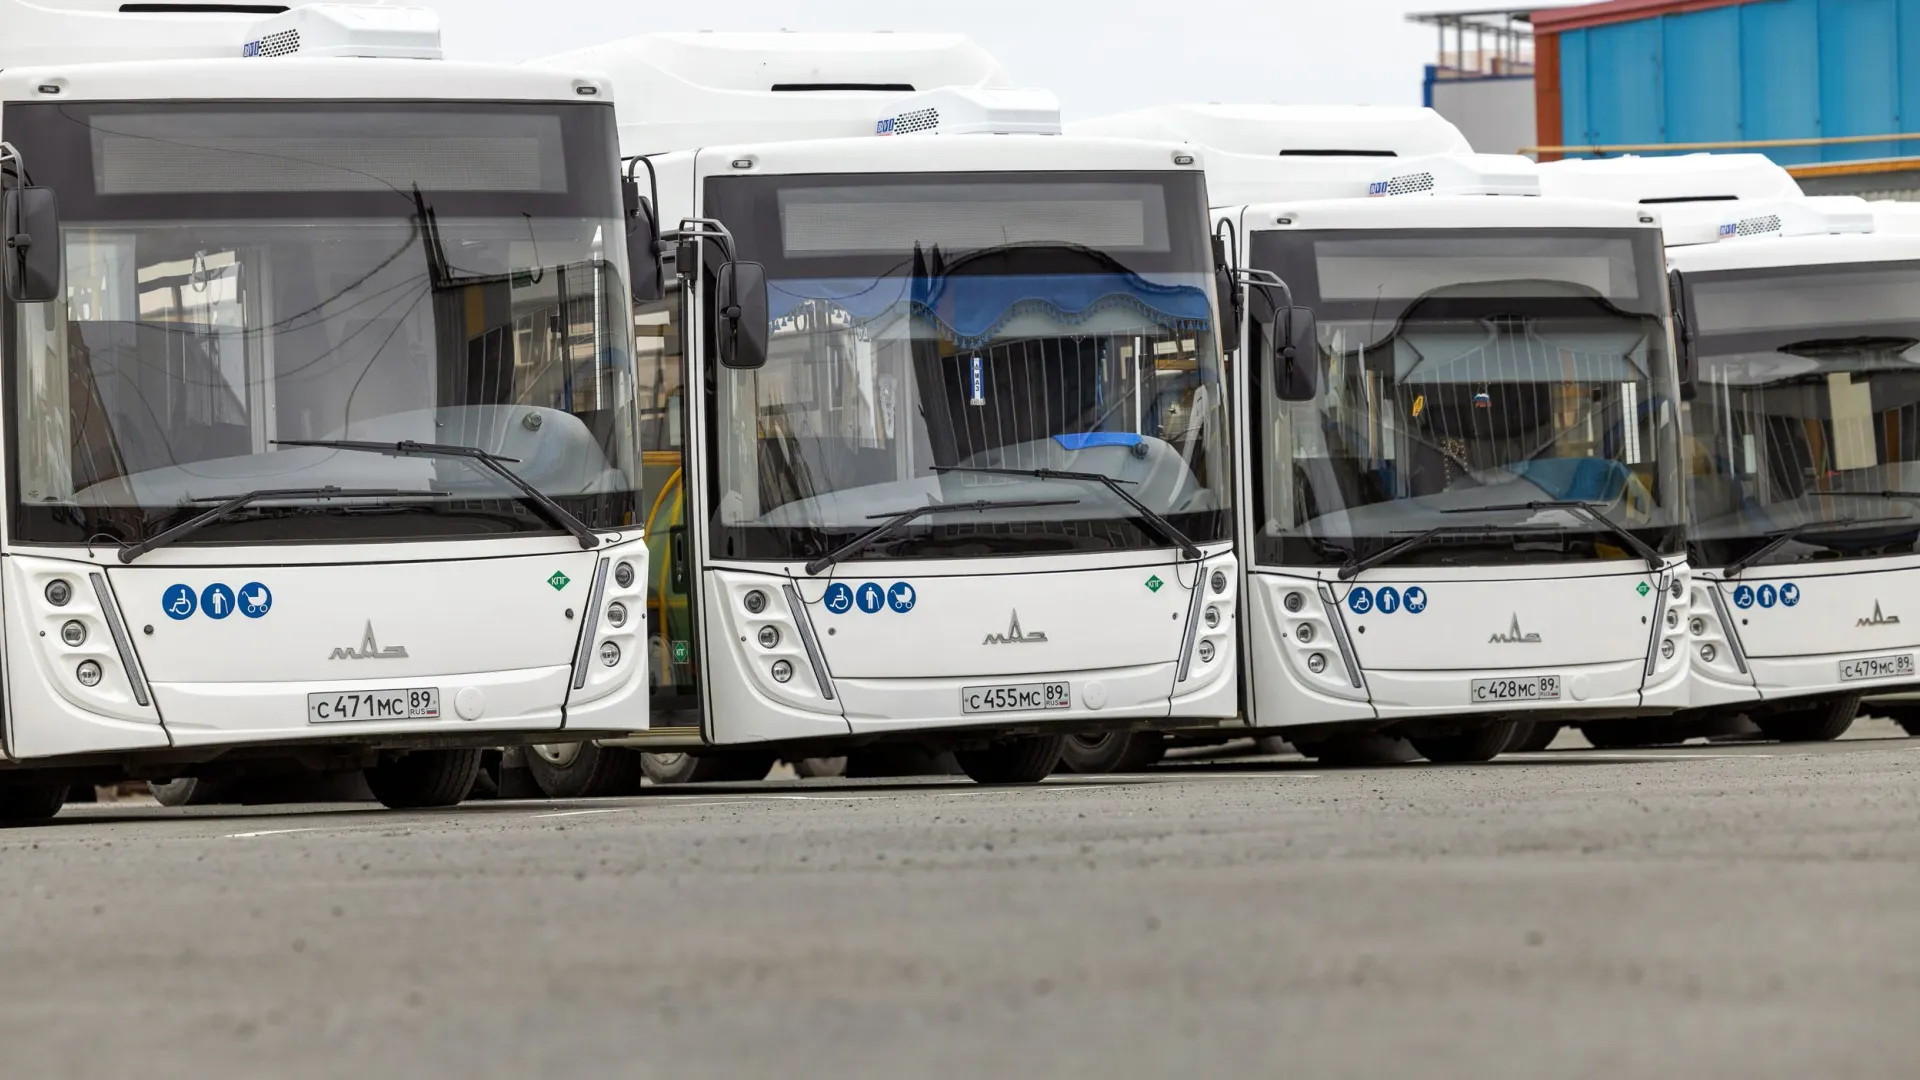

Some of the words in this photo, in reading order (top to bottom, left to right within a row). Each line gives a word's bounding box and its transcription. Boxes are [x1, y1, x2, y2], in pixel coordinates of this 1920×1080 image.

[551, 576, 567, 586] КПГ
[1148, 579, 1161, 588] КПГ
[1897, 656, 1910, 668] 89
[1540, 678, 1555, 691] 89
[1046, 685, 1063, 700] 89
[410, 691, 431, 708] 89
